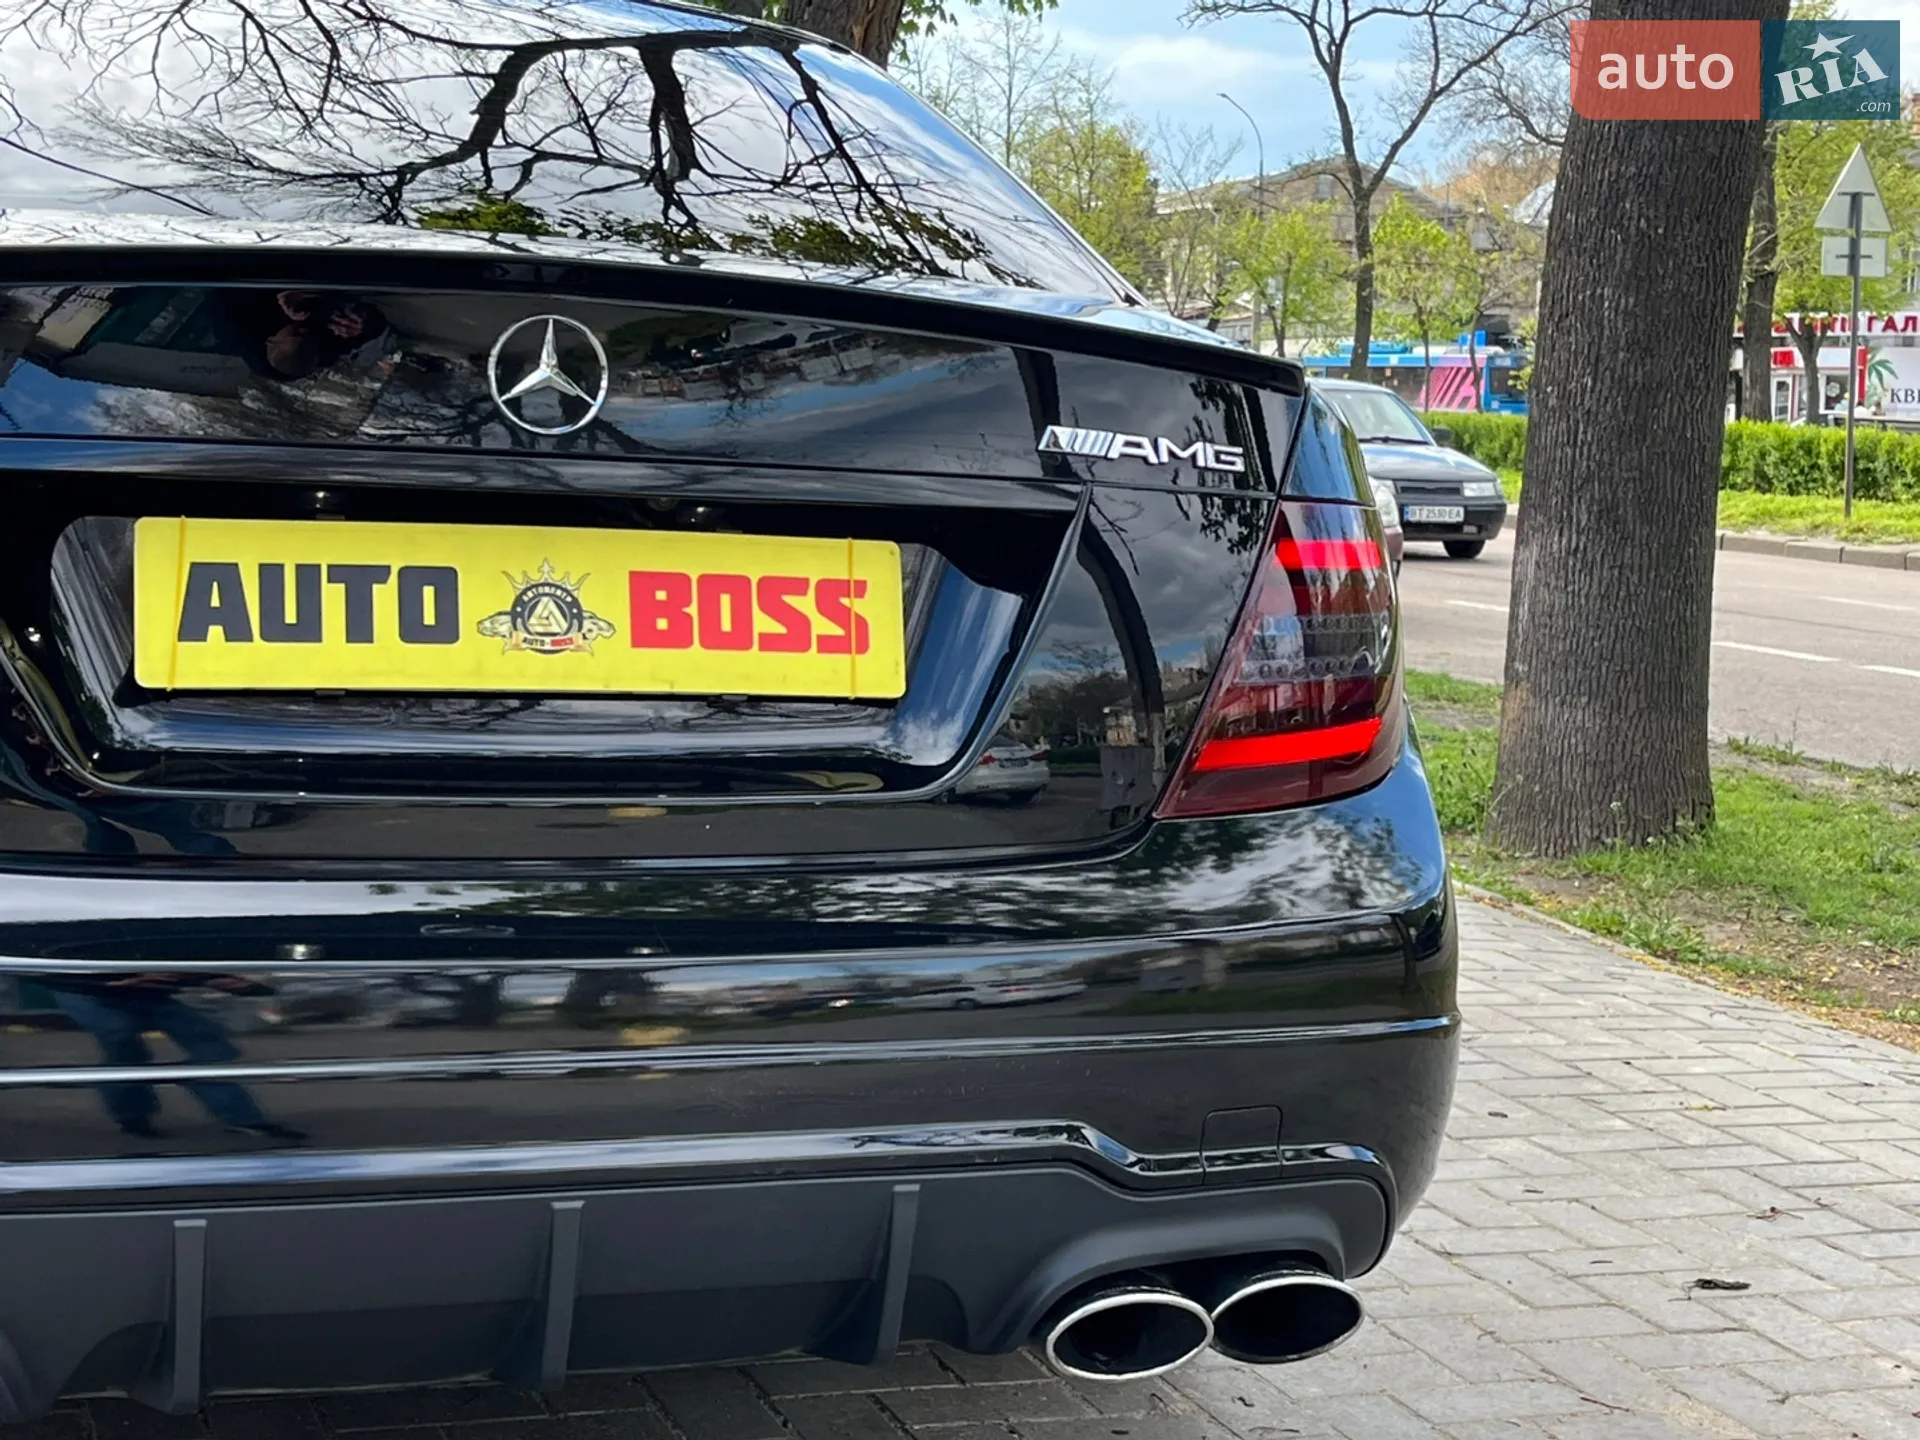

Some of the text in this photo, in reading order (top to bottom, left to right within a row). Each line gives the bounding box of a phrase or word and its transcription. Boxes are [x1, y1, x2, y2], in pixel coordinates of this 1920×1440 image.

[1107, 433, 1245, 472] AMG
[177, 561, 869, 654] AUTO BOSS
